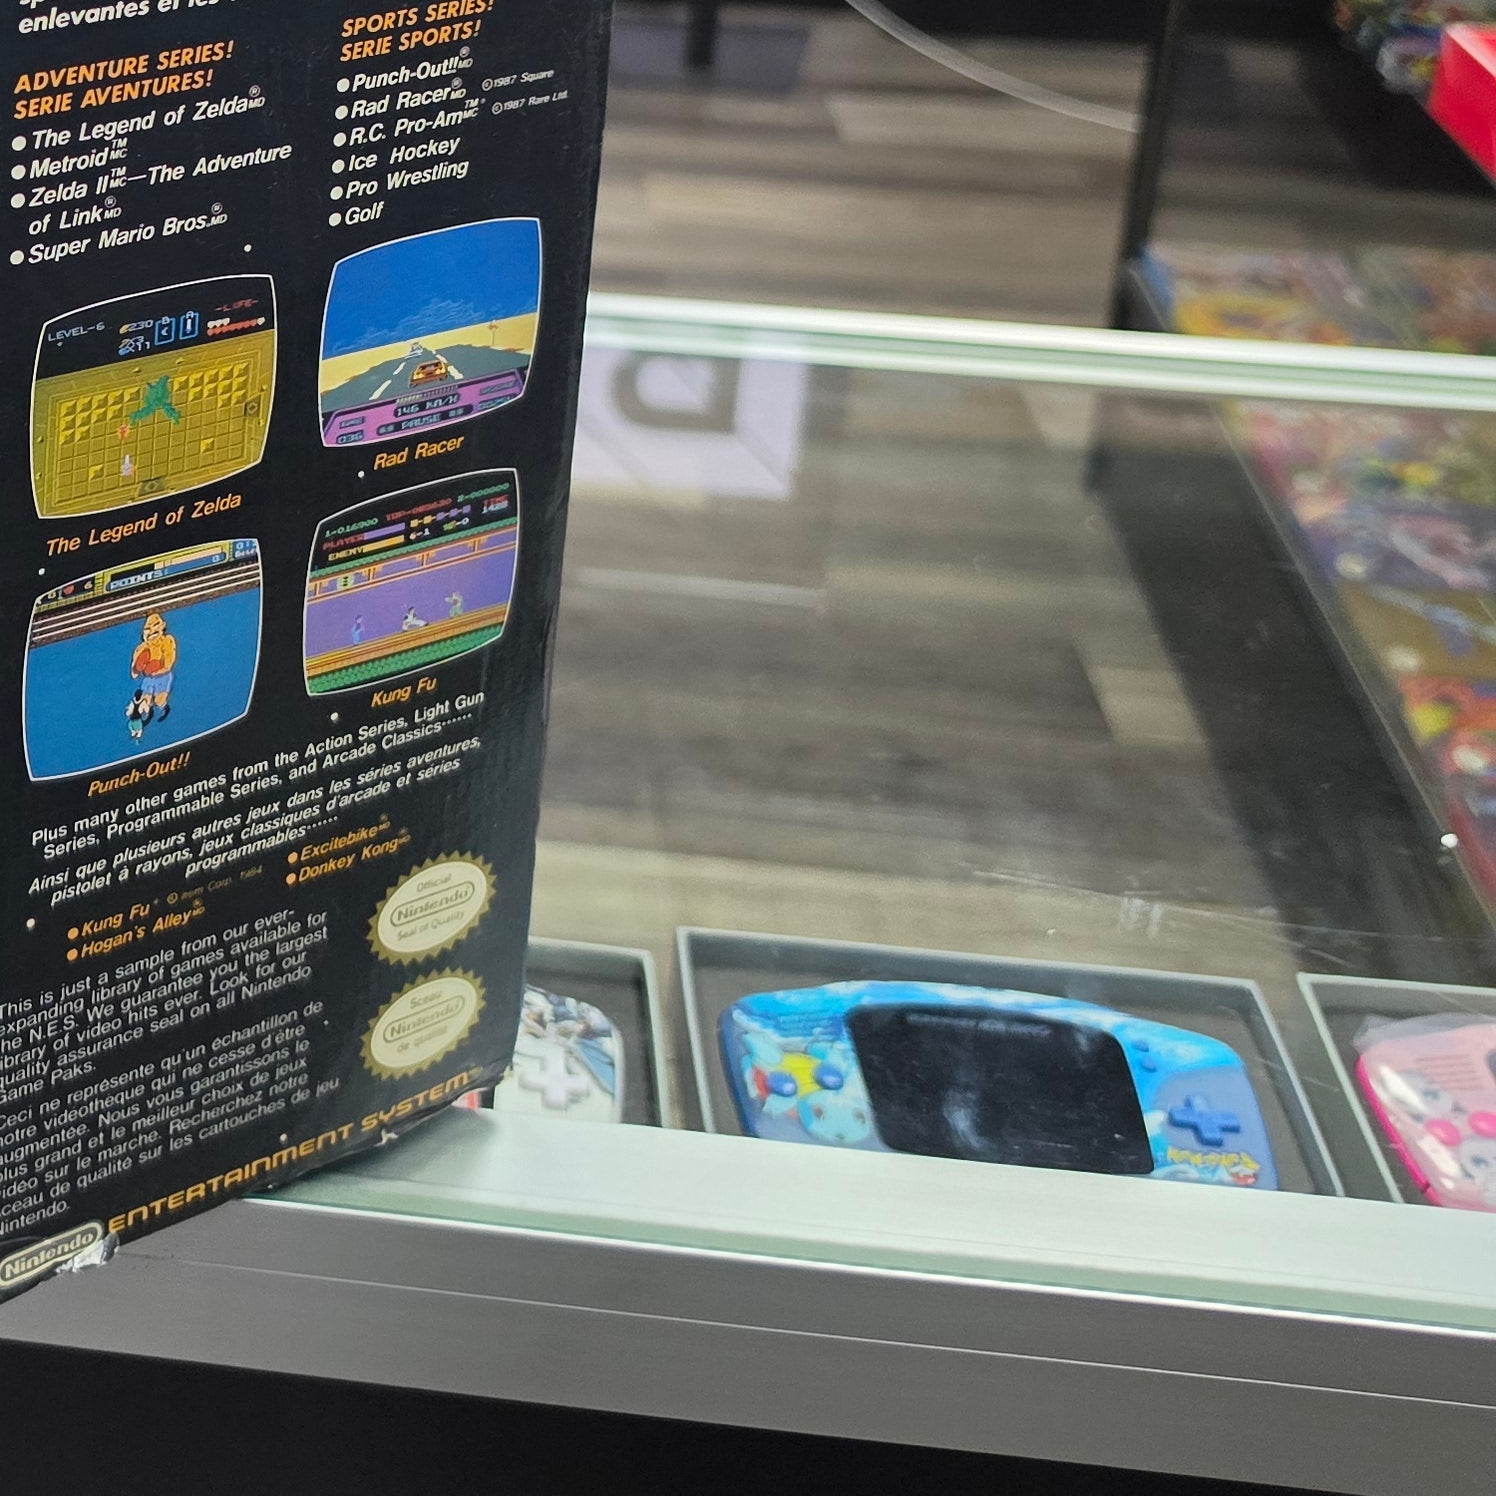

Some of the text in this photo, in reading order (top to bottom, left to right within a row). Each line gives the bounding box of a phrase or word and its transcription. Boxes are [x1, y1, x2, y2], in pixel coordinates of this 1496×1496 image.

[18, 0, 150, 34] enlevantes
[341, 7, 419, 38] SPORTS
[340, 19, 482, 62] SERIE SPORTS!
[13, 40, 234, 94] ADVENTURE SERIES!
[13, 68, 214, 120] SERIE AVENTURES!
[350, 94, 390, 119] Rad
[32, 128, 72, 150] The
[78, 110, 156, 142] Legend
[163, 104, 186, 126] of
[349, 122, 386, 146] R.C.
[192, 145, 292, 177] Adventure
[348, 137, 461, 172] Ice Hockey
[345, 161, 470, 199] Pro Wrestling
[28, 213, 52, 235] of
[345, 200, 385, 225] Golf
[28, 238, 91, 264] Super
[98, 223, 155, 250] Mario
[373, 436, 465, 471] Rad Racer
[46, 493, 242, 557] The Legend of Zelda
[371, 676, 437, 708] Kung Fu
[32, 691, 485, 846] Plus many other games from the Action Series, Light Gun
[87, 751, 191, 797] Punch-Out!!
[43, 833, 100, 860] Series,
[107, 791, 225, 840] Programmable
[230, 774, 283, 799] Series,
[288, 758, 317, 780] and
[322, 742, 377, 769] Arcade
[298, 853, 356, 882] Donkey
[81, 903, 151, 937] Kung Fu
[397, 886, 469, 922] Nintendo
[39, 991, 54, 1006] is
[60, 976, 91, 1001] just
[97, 971, 109, 986] a
[115, 949, 175, 979] sample
[181, 934, 217, 956] from
[222, 922, 249, 942] our
[254, 909, 295, 932] ever-
[81, 925, 146, 958] Hogan's
[5, 1231, 94, 1278] Nintendo
[108, 1121, 354, 1234] ENTERTAINMENT
